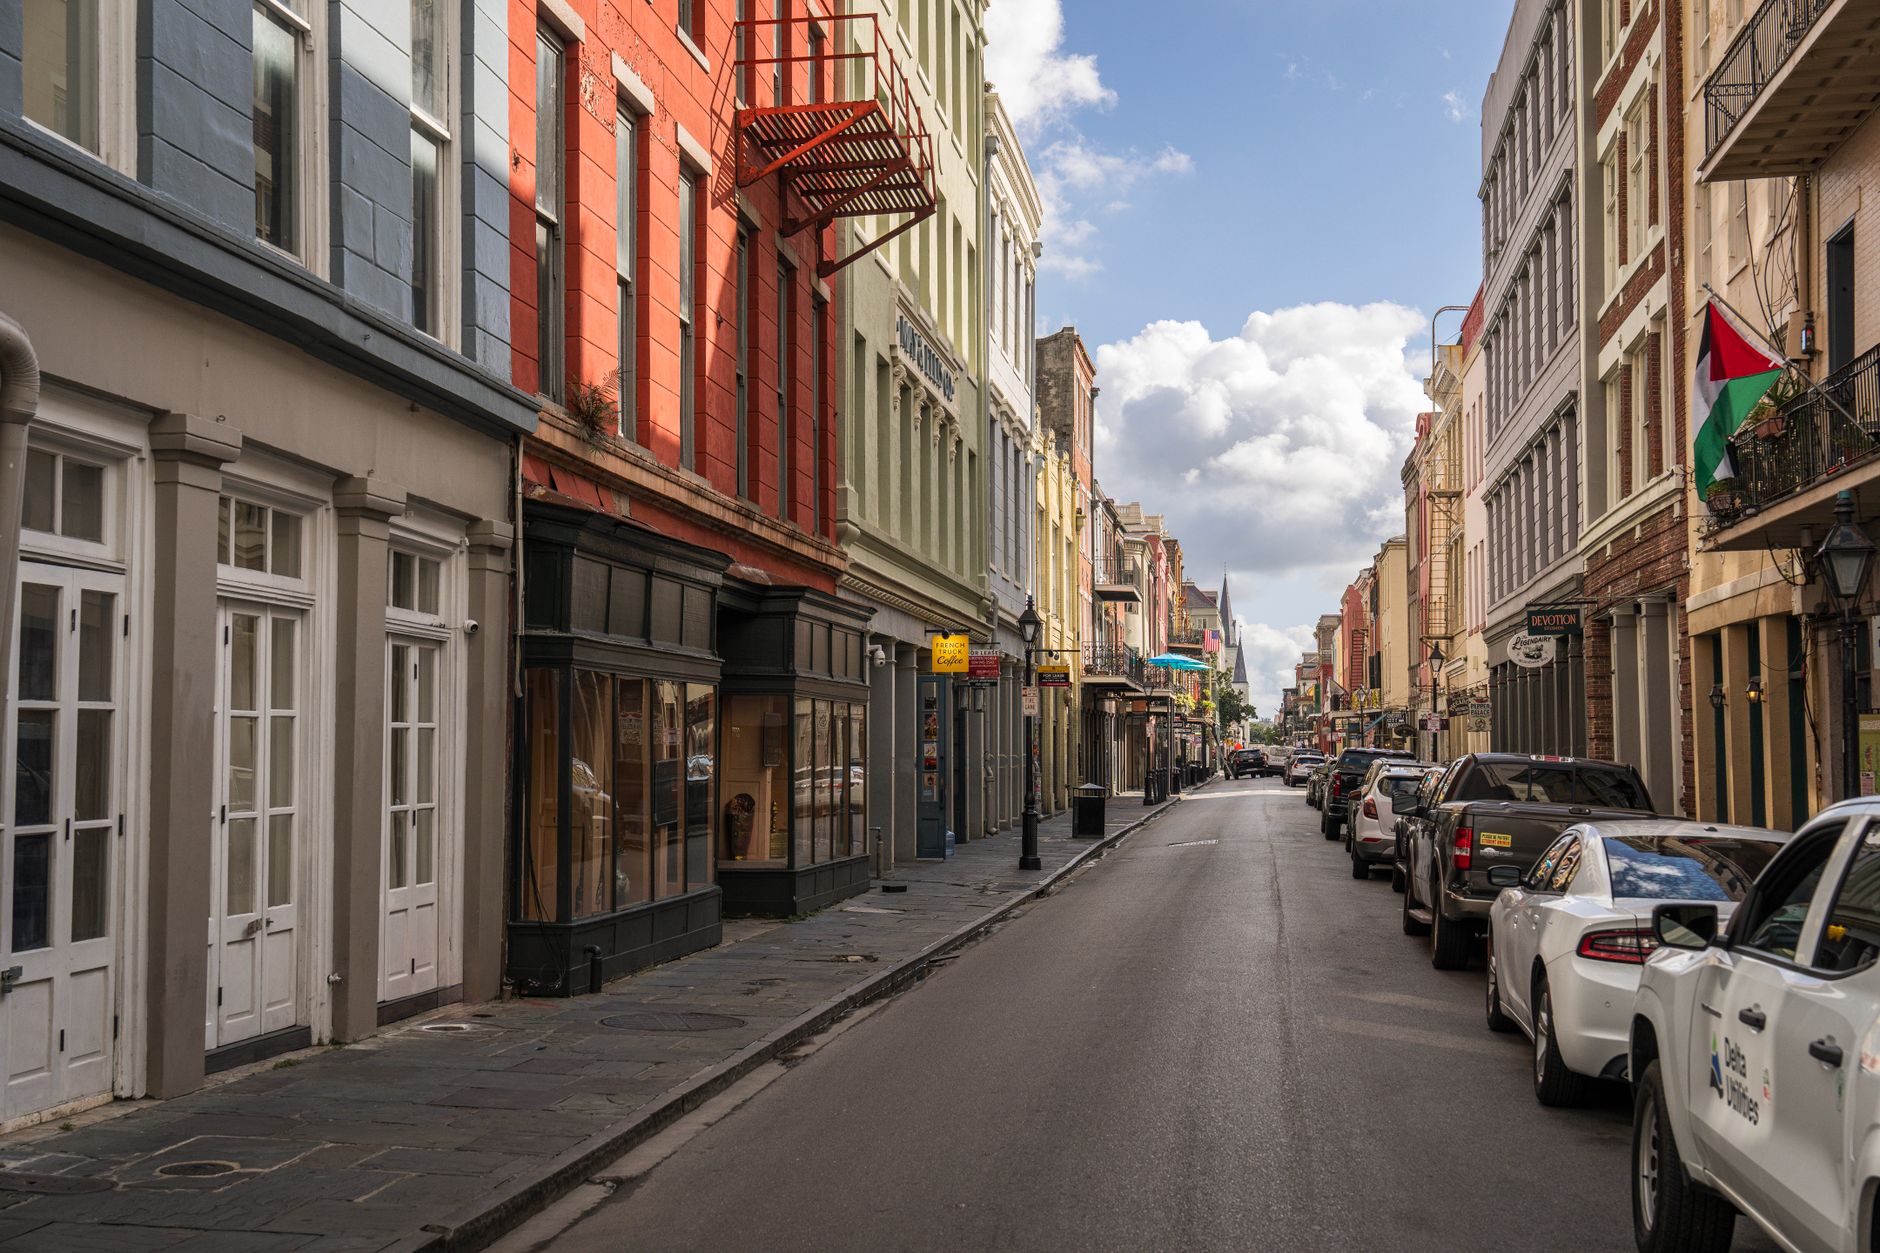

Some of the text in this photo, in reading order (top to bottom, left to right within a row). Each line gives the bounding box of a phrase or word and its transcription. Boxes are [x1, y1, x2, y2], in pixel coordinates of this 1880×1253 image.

[1532, 614, 1576, 626] DEVOTION
[937, 656, 964, 667] Coffee
[1724, 1036, 1747, 1078] Delta
[1726, 1075, 1759, 1126] Utilities
